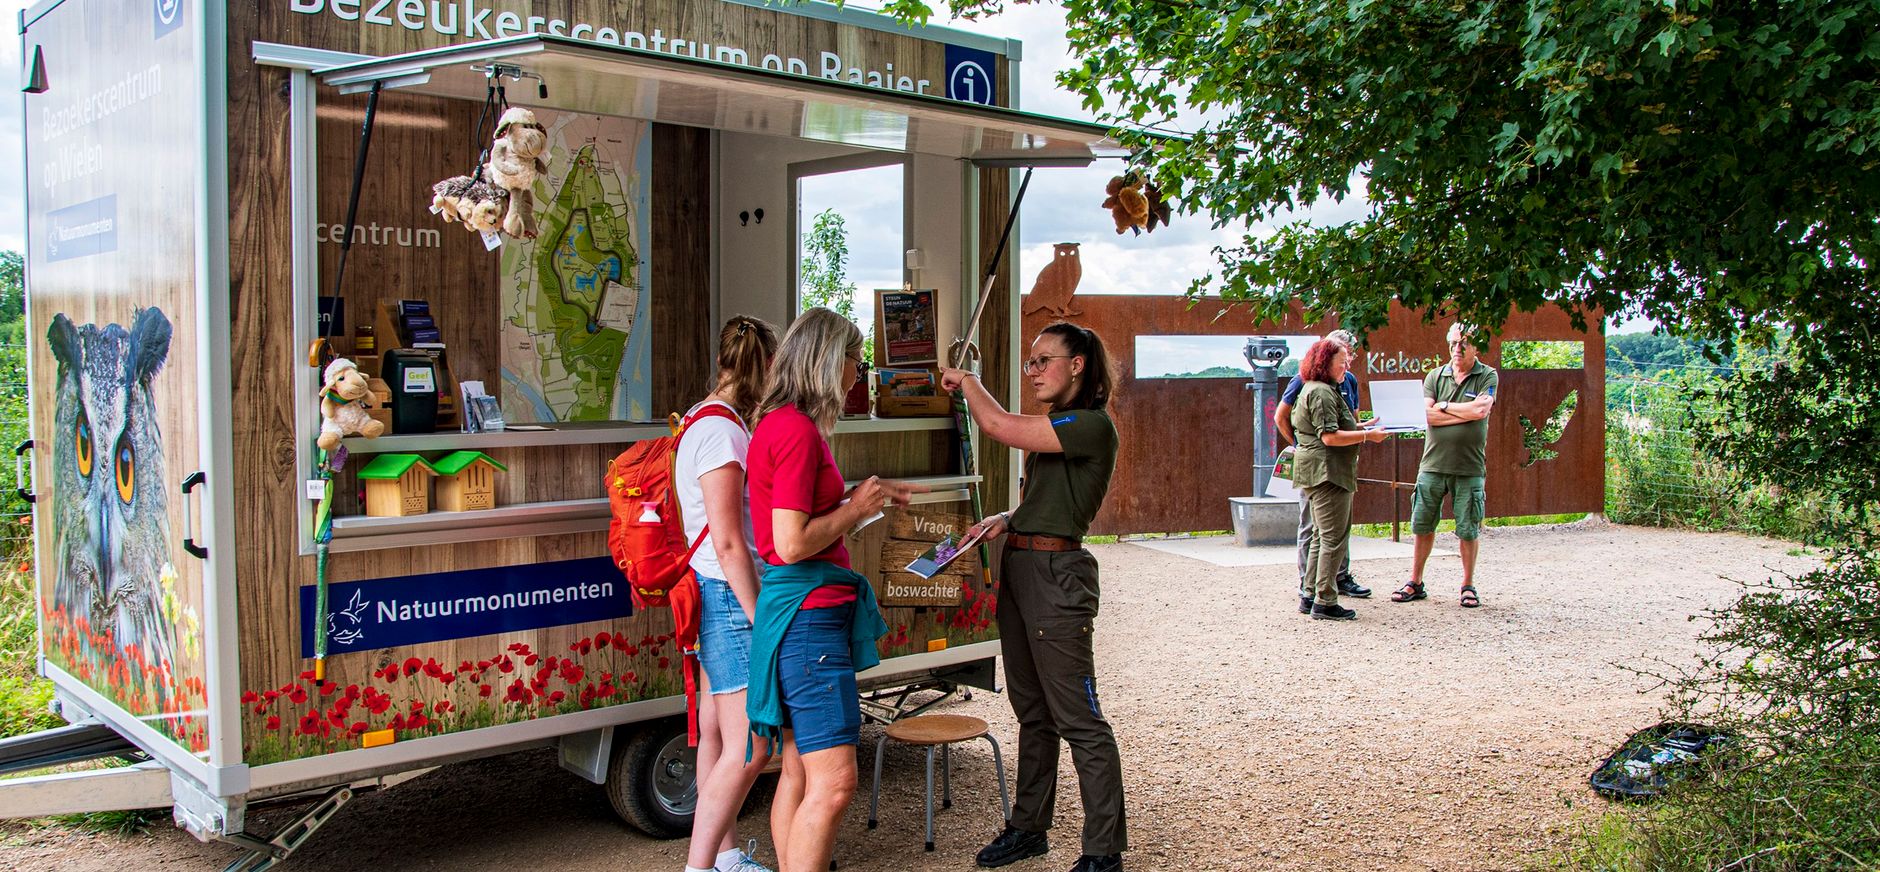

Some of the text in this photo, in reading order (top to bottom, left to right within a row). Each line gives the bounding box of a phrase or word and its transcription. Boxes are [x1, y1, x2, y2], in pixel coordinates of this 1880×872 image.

[43, 63, 161, 142] Bezoekerscentrum
[44, 135, 103, 199] op Wielen
[408, 371, 429, 380] Geef
[1366, 350, 1443, 375] Kiekoet
[377, 582, 614, 624] Natuurmonumenten
[887, 580, 960, 598] boswachter
